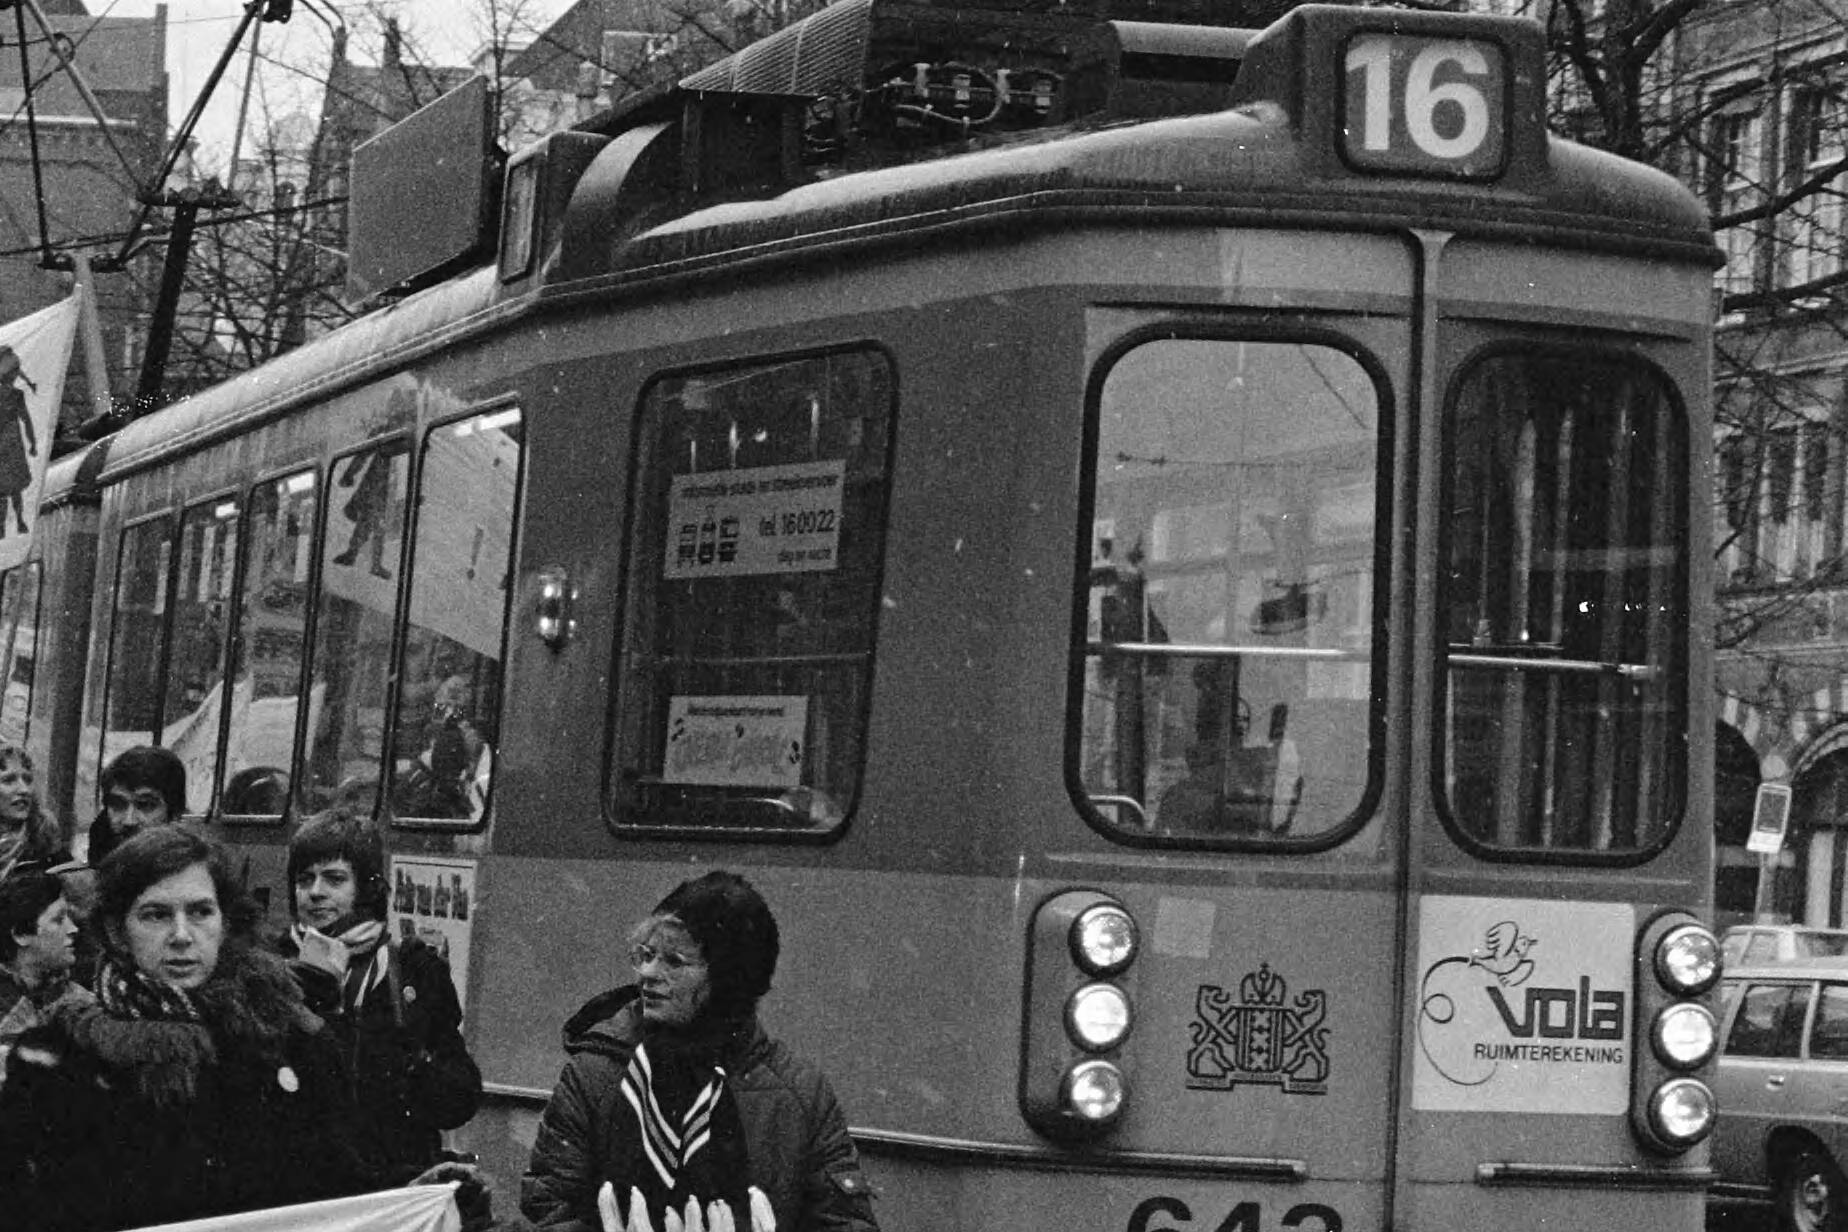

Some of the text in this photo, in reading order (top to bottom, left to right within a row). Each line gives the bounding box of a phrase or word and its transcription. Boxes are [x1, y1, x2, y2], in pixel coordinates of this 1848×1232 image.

[1344, 38, 1490, 160] 16
[782, 508, 836, 535] 160022
[1473, 1043, 1624, 1065] RUIMTEREKENING
